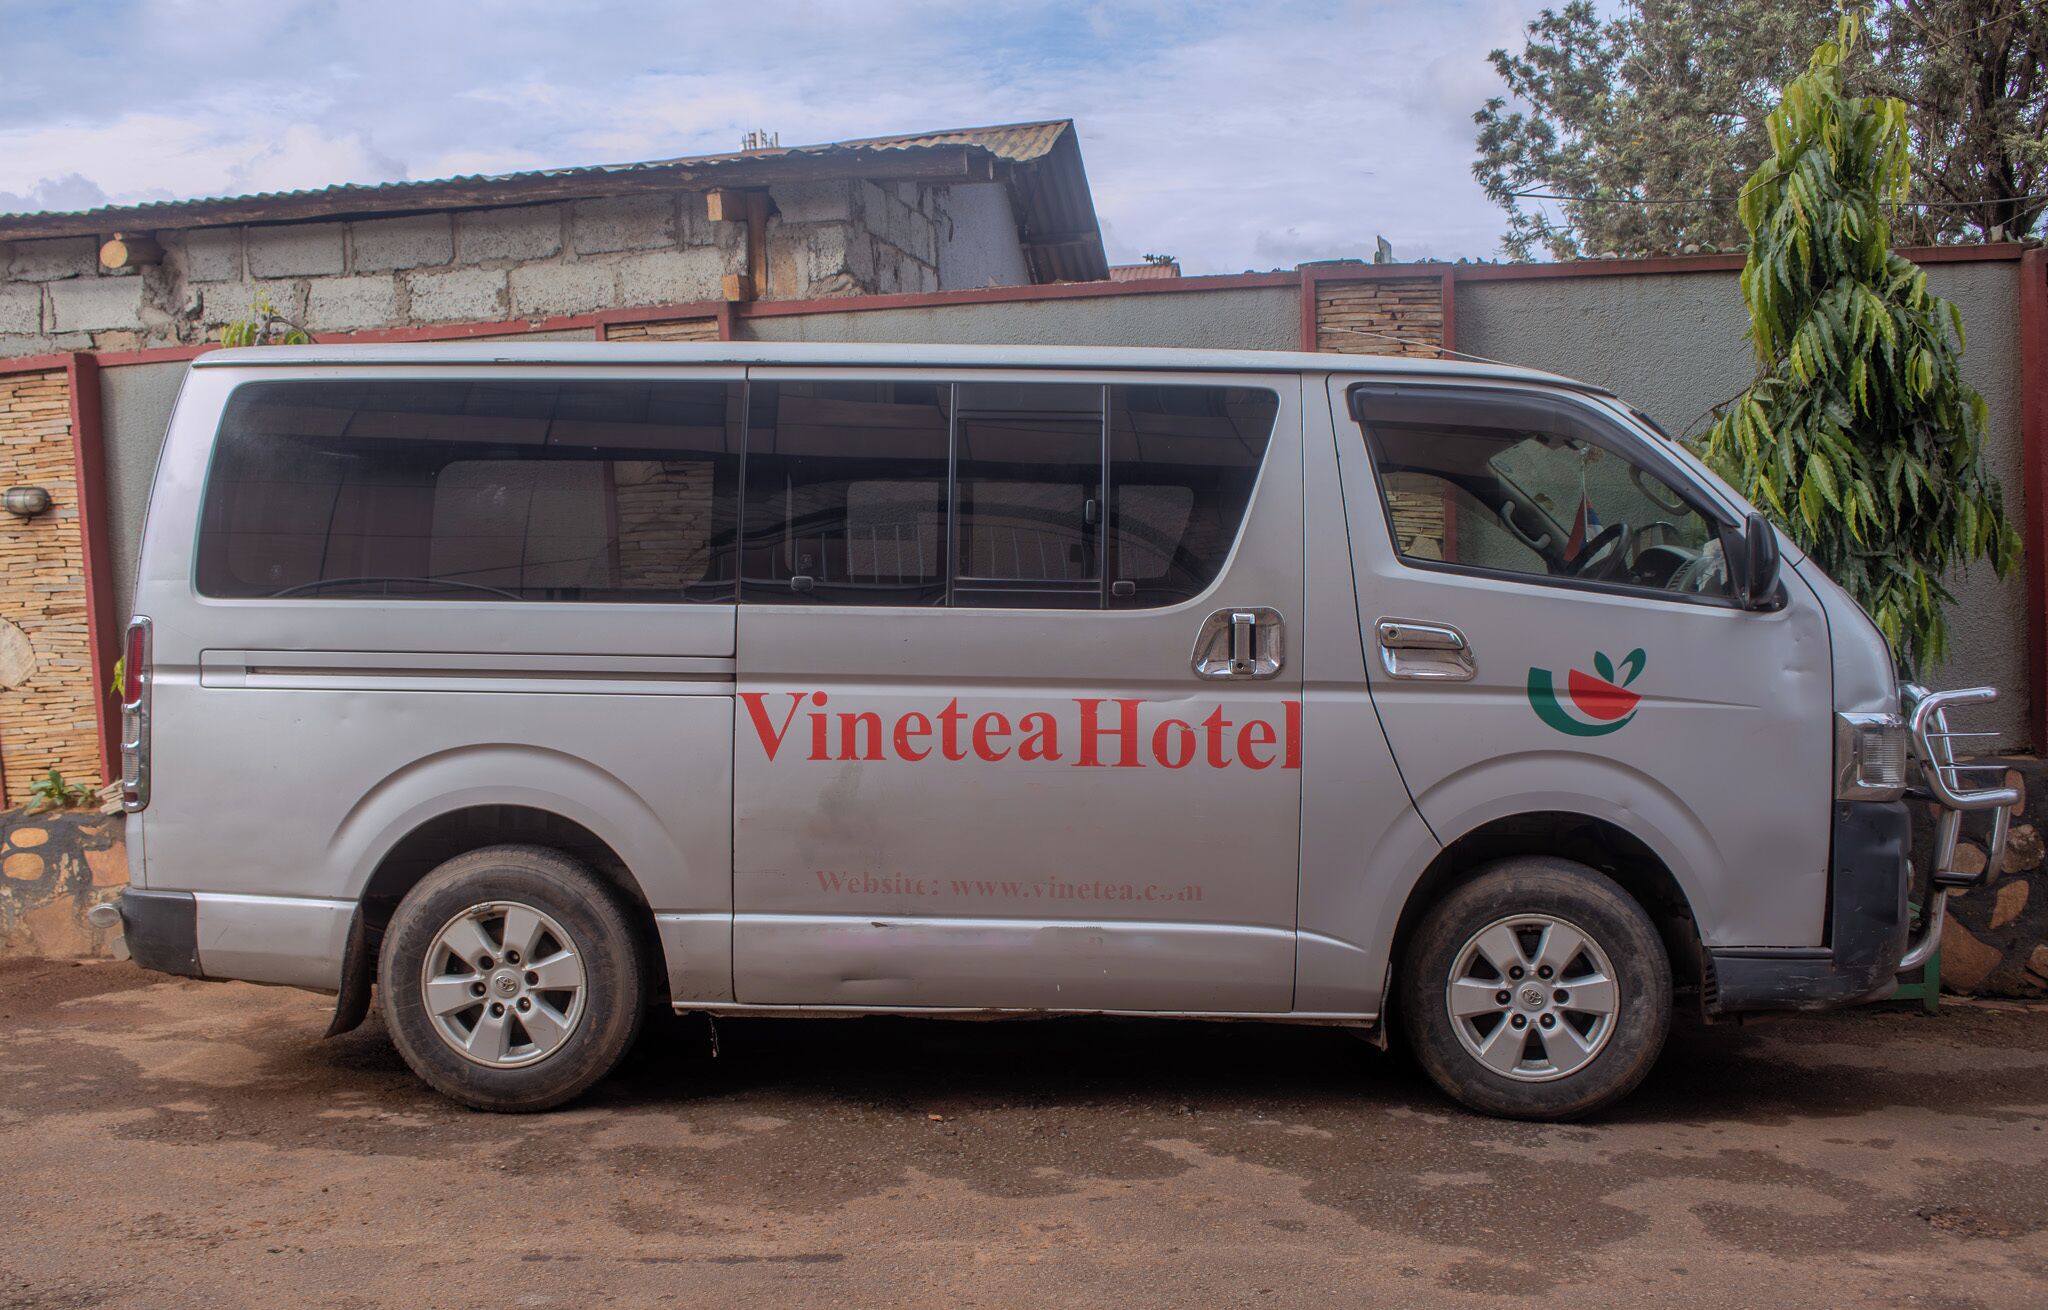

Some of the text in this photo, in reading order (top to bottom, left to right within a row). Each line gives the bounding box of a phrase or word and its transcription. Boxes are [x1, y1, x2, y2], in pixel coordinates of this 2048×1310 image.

[738, 691, 1302, 769] Vinetea Hotel
[815, 870, 939, 897] Website:
